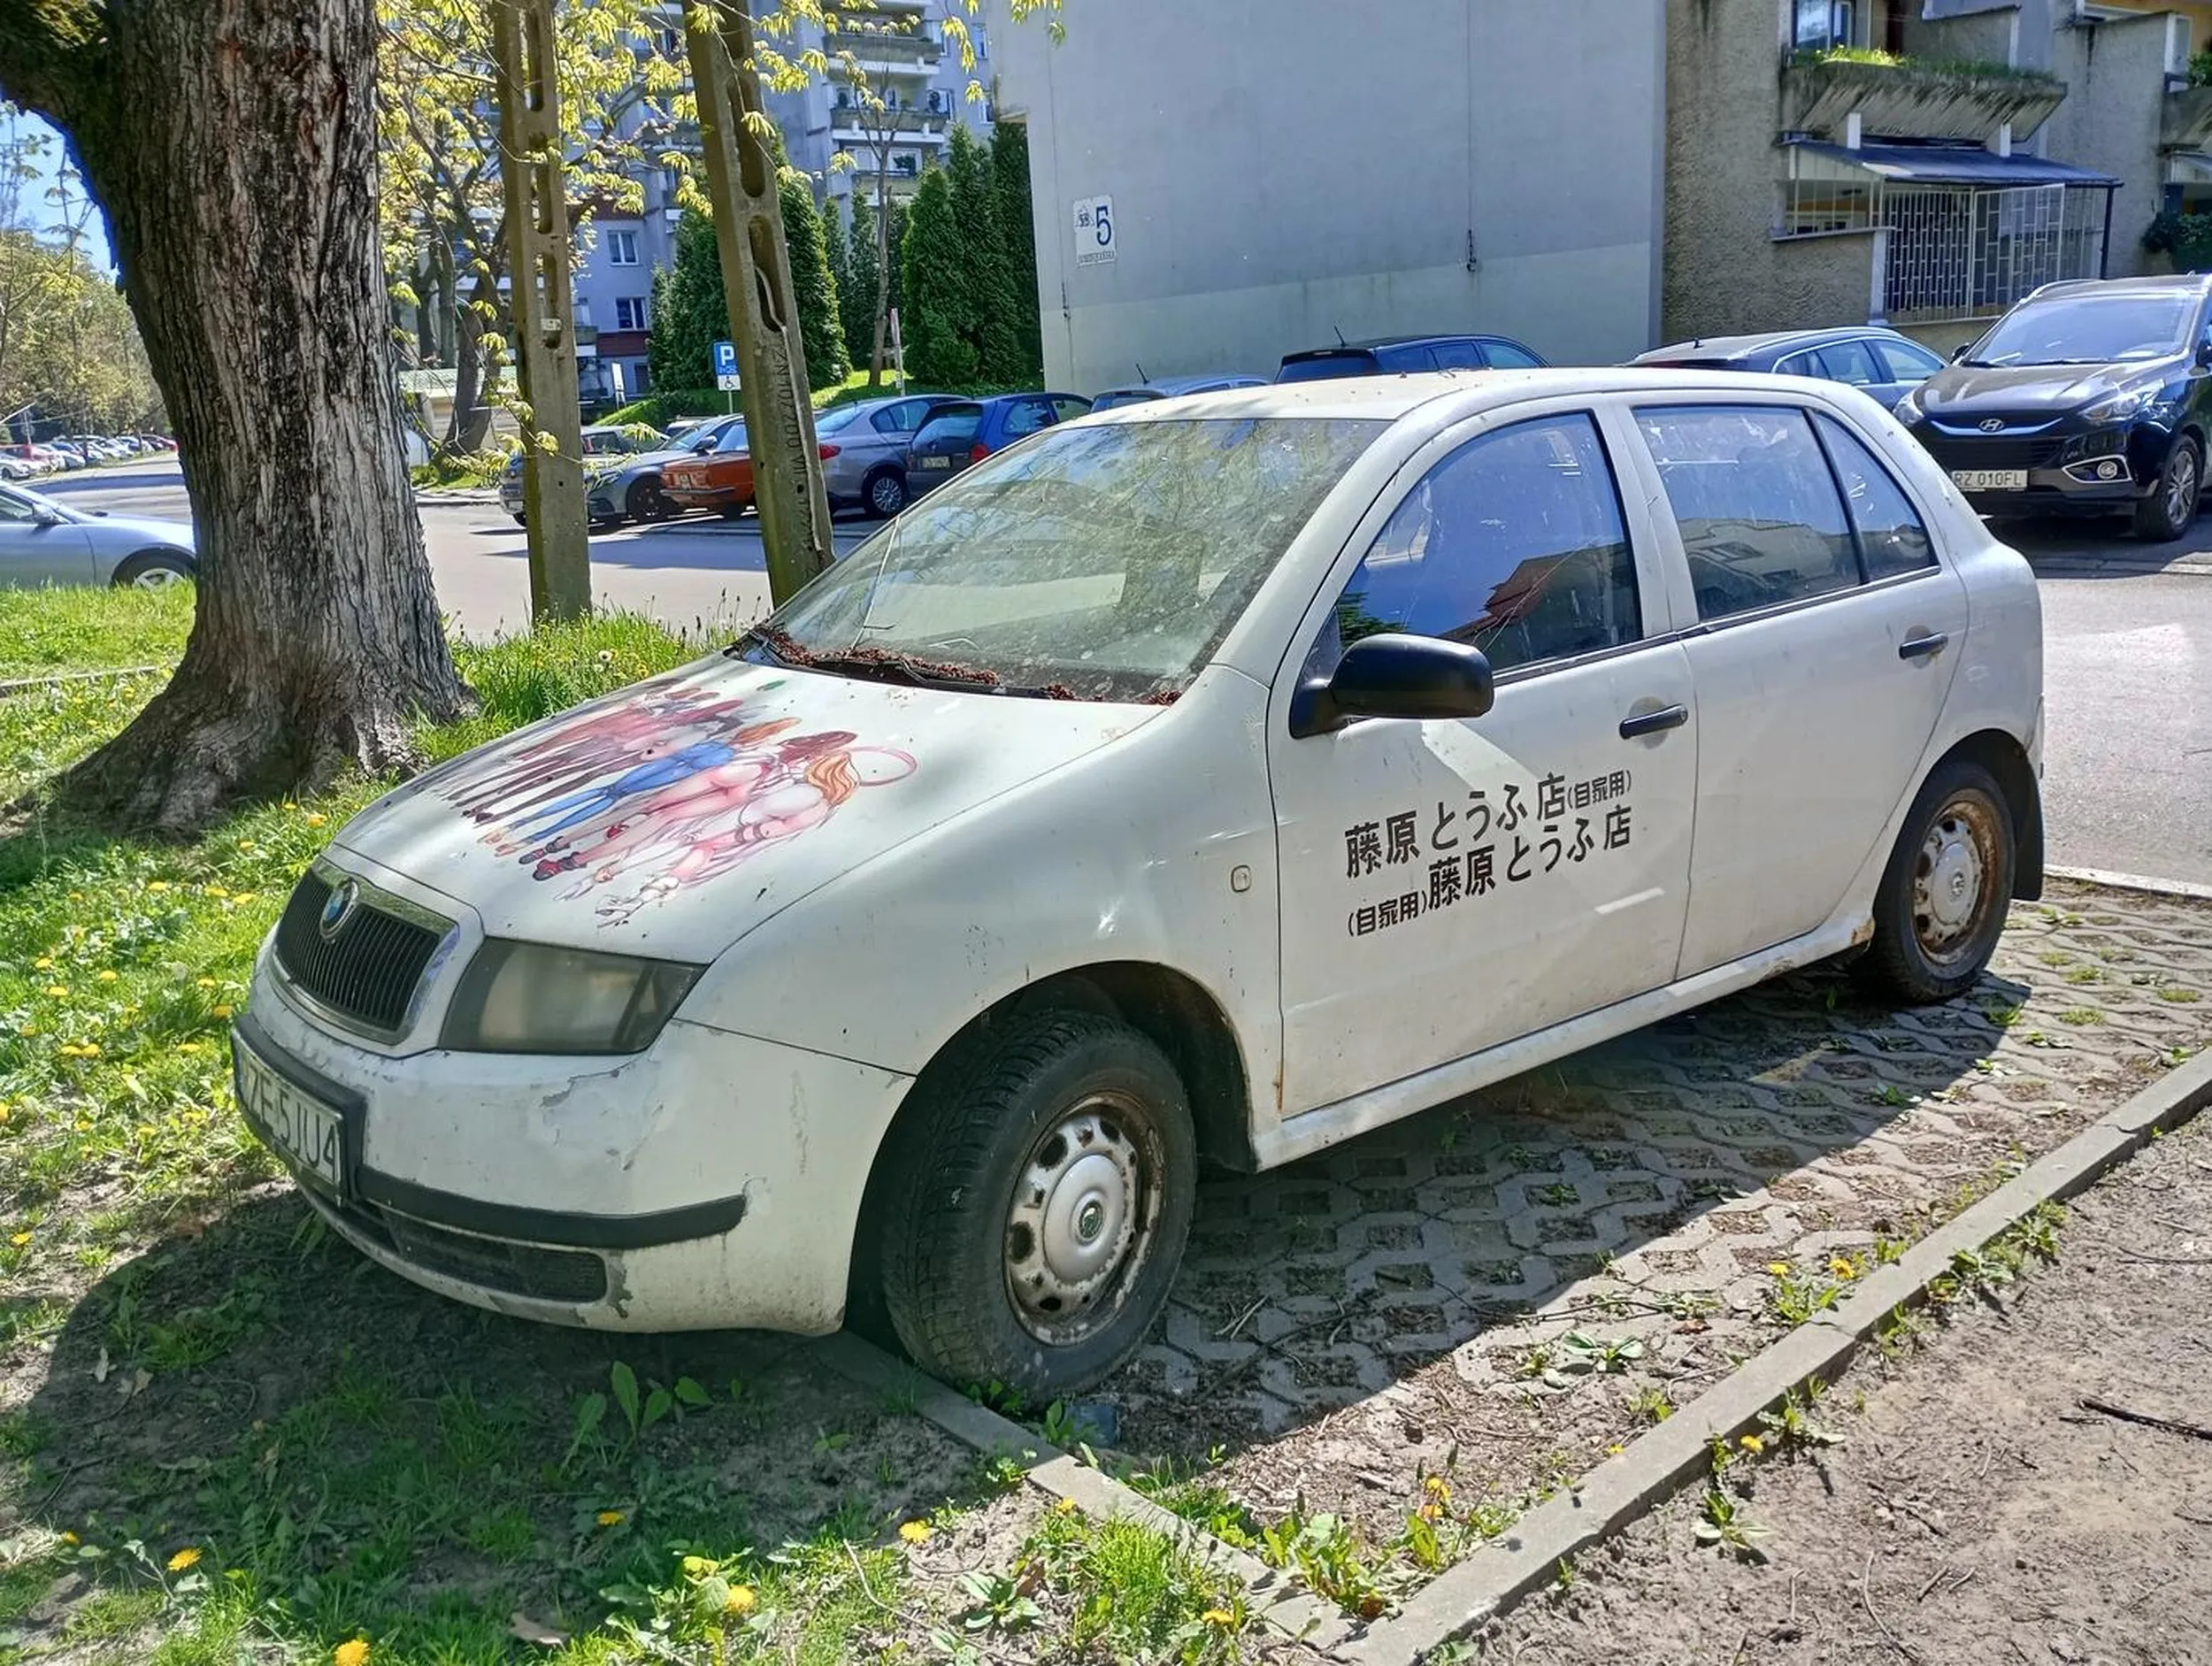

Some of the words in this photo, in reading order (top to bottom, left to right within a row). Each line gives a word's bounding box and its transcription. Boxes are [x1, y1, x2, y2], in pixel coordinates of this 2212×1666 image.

[1096, 205, 1112, 246] 5
[720, 345, 735, 365] P
[1978, 472, 2022, 486] 010FL
